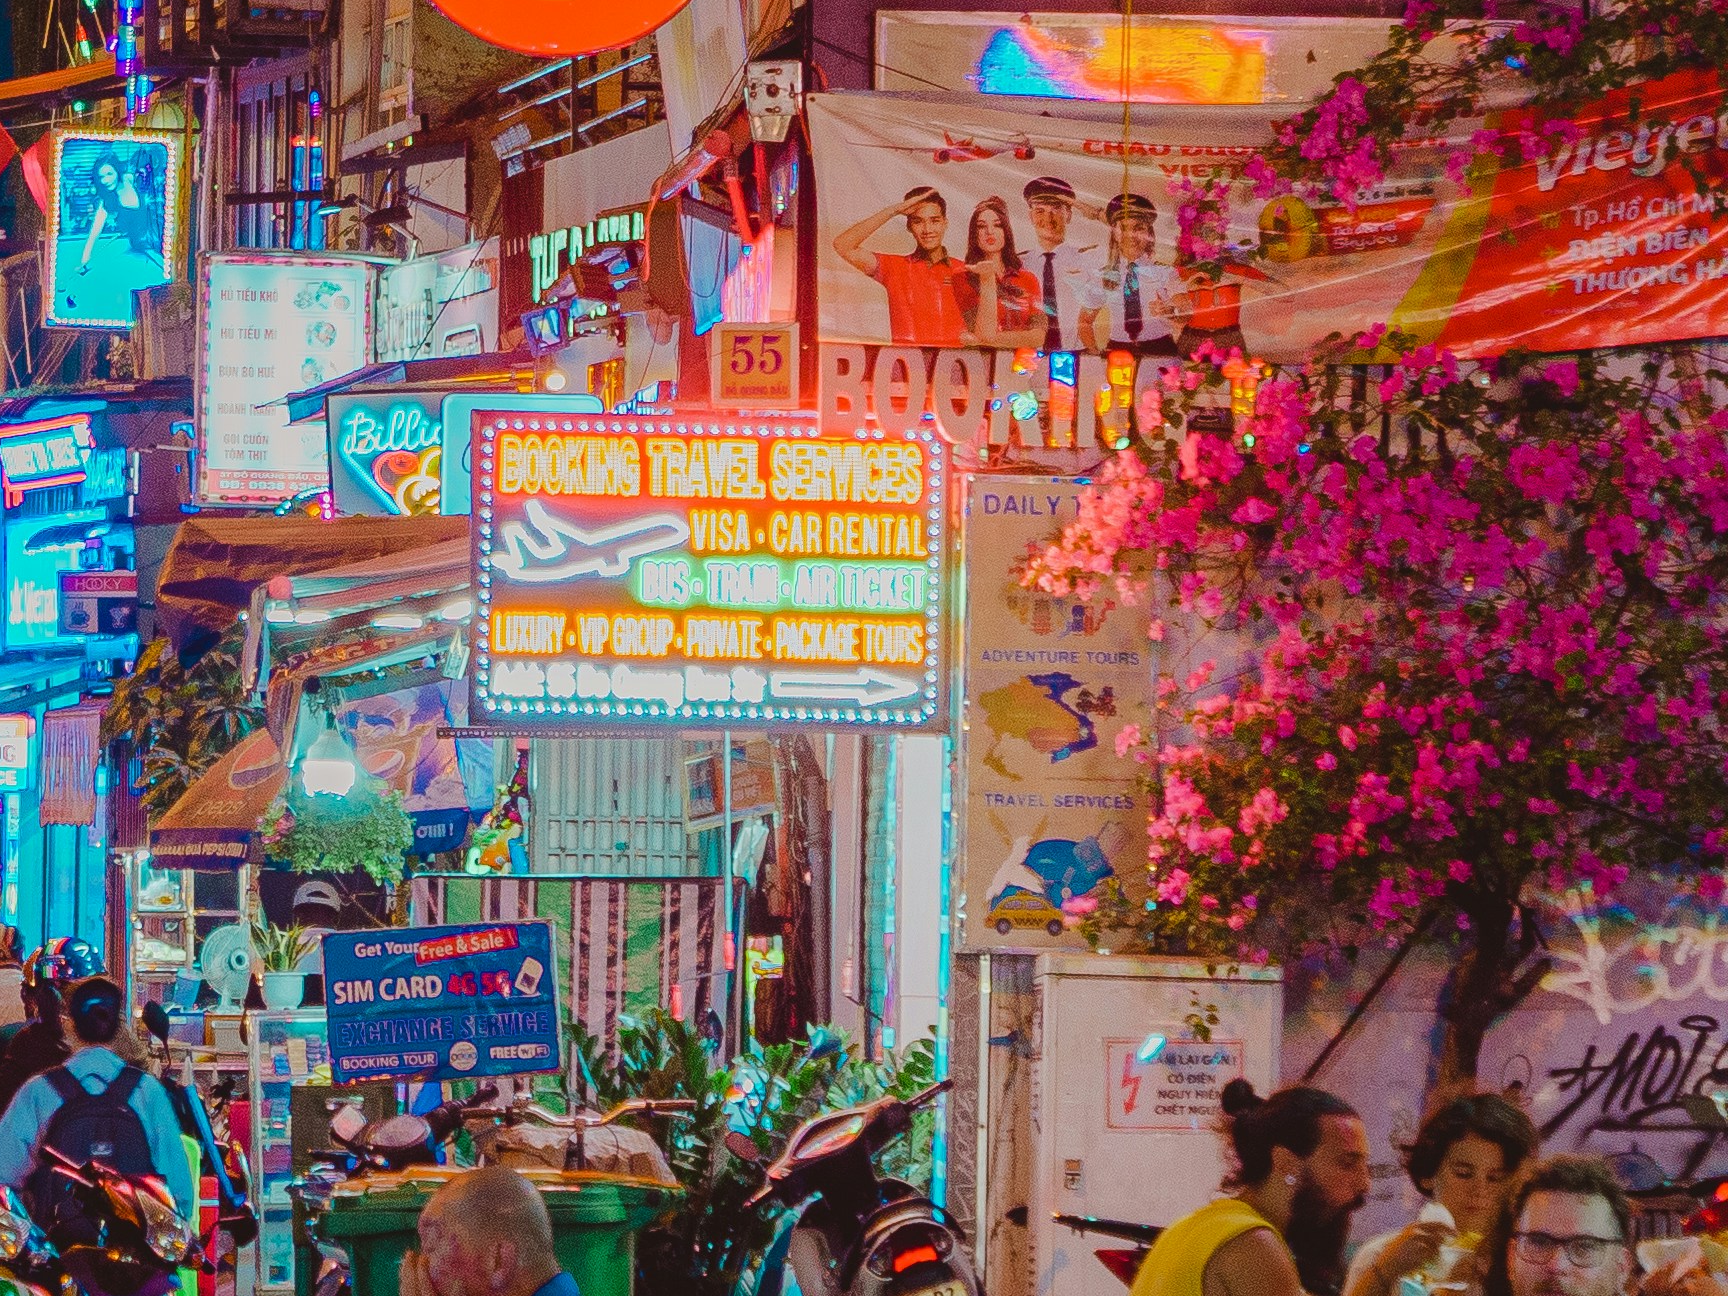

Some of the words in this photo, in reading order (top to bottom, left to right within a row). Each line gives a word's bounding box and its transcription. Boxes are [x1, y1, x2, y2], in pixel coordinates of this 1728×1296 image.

[731, 335, 783, 375] 55
[500, 435, 640, 496] BOOKING
[645, 438, 766, 500] TRAVEL
[769, 441, 923, 504] SERVICES
[983, 494, 1060, 516] DAILY
[690, 508, 751, 551] VISA
[769, 510, 823, 554] CAR
[827, 513, 927, 556] RENTAL
[75, 578, 122, 590] HOOKY
[642, 561, 690, 604] BUS
[707, 563, 779, 605] TRAIN
[794, 565, 838, 606] AIR
[840, 566, 926, 608] TICKET
[493, 612, 566, 653] LUXURY
[576, 614, 609, 654] VIP
[612, 614, 673, 656] GROUP
[684, 616, 763, 658] PRIVATE
[771, 616, 860, 660] PACKAGE
[862, 619, 924, 663] TOURS
[981, 650, 1078, 665] ADVENTURE
[1086, 651, 1139, 667] TOURS
[984, 793, 1045, 809] TRAVEL
[1053, 794, 1134, 811] SERVICES
[354, 942, 381, 958] Get
[385, 942, 419, 956] Your
[419, 941, 453, 960] Free
[456, 935, 468, 954] &
[470, 930, 504, 951] Sale
[334, 980, 374, 1004] SIM
[379, 975, 442, 1001] CARD
[448, 972, 477, 996] 4G
[335, 1016, 454, 1047] EXCHANGE
[457, 1011, 550, 1040] SERVICE
[343, 1056, 399, 1070] BOOKING
[403, 1053, 435, 1066] TOUR
[489, 1046, 517, 1059] FREE
